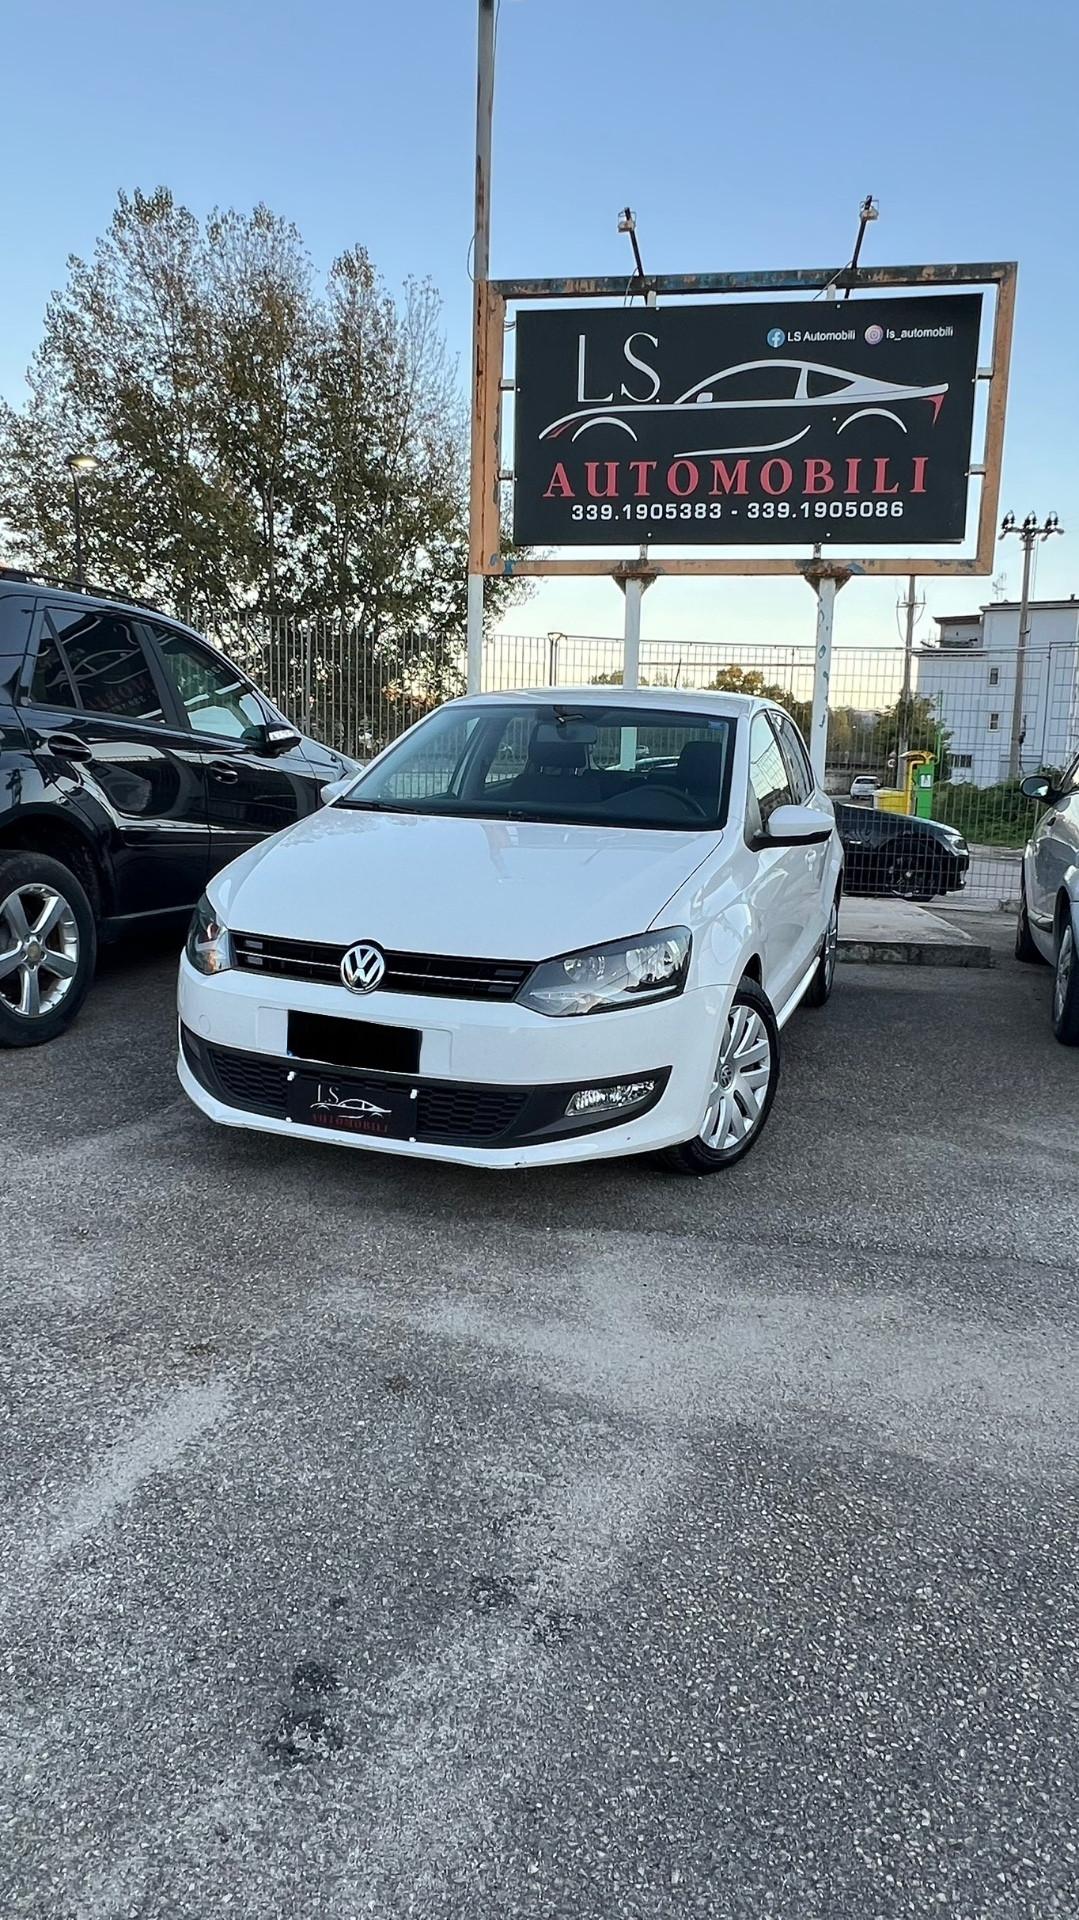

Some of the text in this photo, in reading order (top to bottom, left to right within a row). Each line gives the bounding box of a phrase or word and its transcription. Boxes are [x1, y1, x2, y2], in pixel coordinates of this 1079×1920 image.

[787, 329, 856, 342] LS Automobili
[886, 325, 954, 341] ls_automobili
[542, 456, 929, 498] AUTOMOBILI
[571, 503, 722, 521] 339.1905383
[747, 501, 904, 519] 339.1905086
